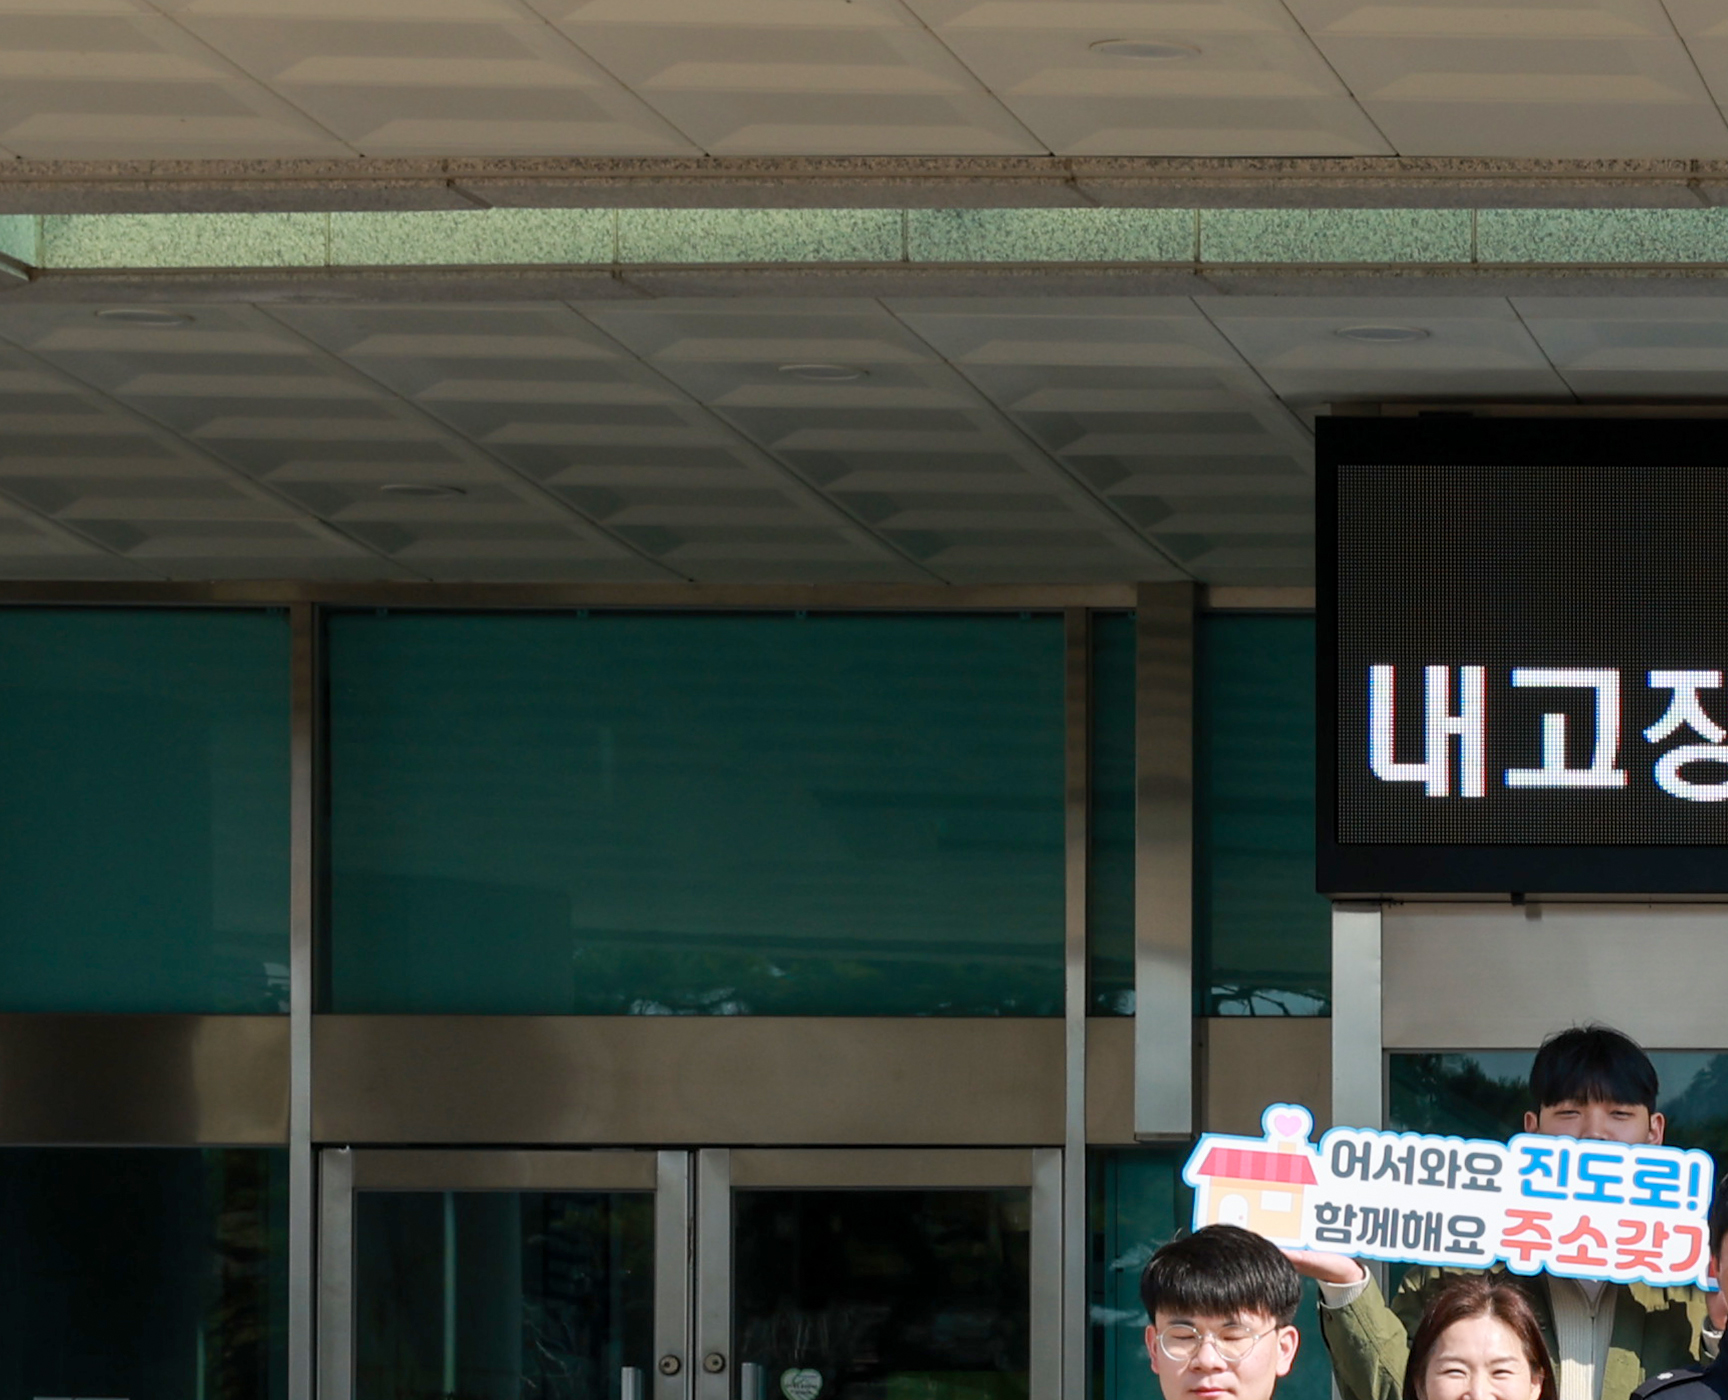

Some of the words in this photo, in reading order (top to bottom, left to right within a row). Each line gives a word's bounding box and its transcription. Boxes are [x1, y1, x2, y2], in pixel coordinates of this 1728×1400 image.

[1330, 1138, 1502, 1194] 어서와요
[1517, 1145, 1701, 1212] 진도로!
[1313, 1200, 1487, 1257] 함께해요
